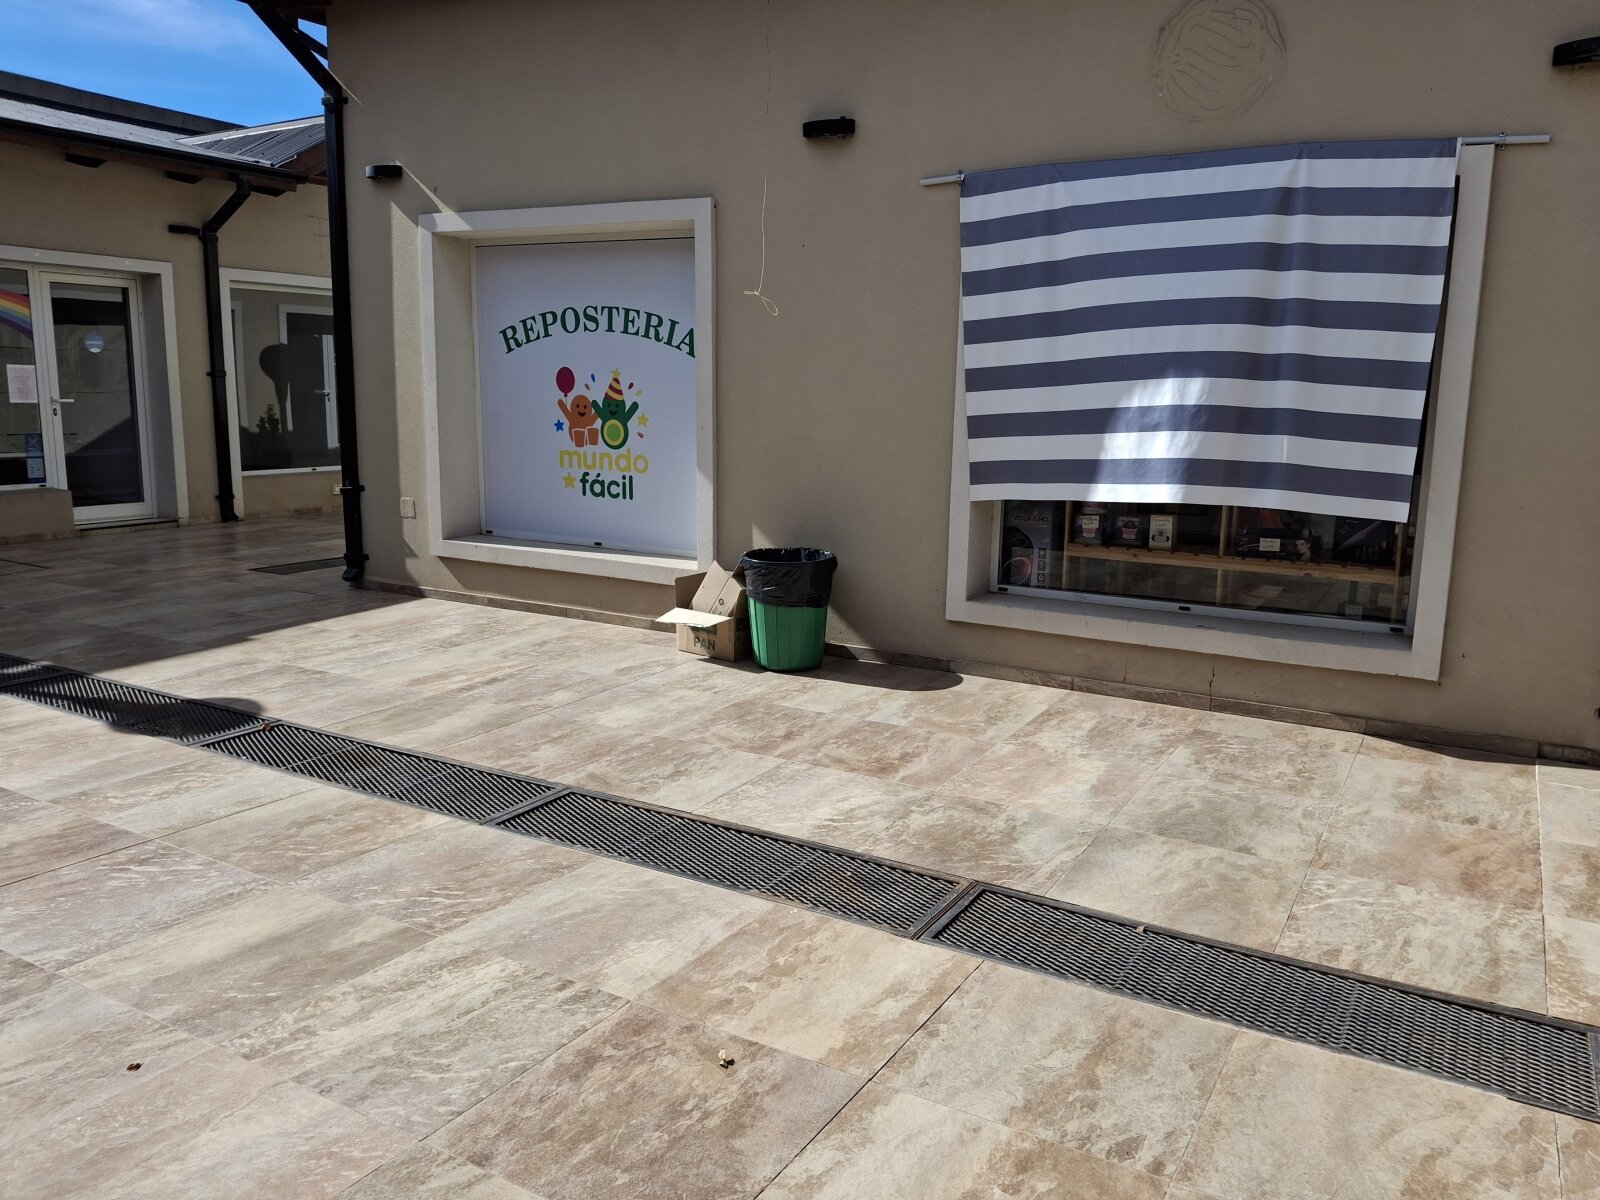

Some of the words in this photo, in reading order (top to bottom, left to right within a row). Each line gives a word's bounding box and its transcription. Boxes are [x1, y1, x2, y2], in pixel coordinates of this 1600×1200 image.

[499, 305, 696, 358] REPOSTERIA
[559, 448, 649, 474] mundo
[580, 472, 634, 500] fácil
[693, 636, 716, 651] PAN
